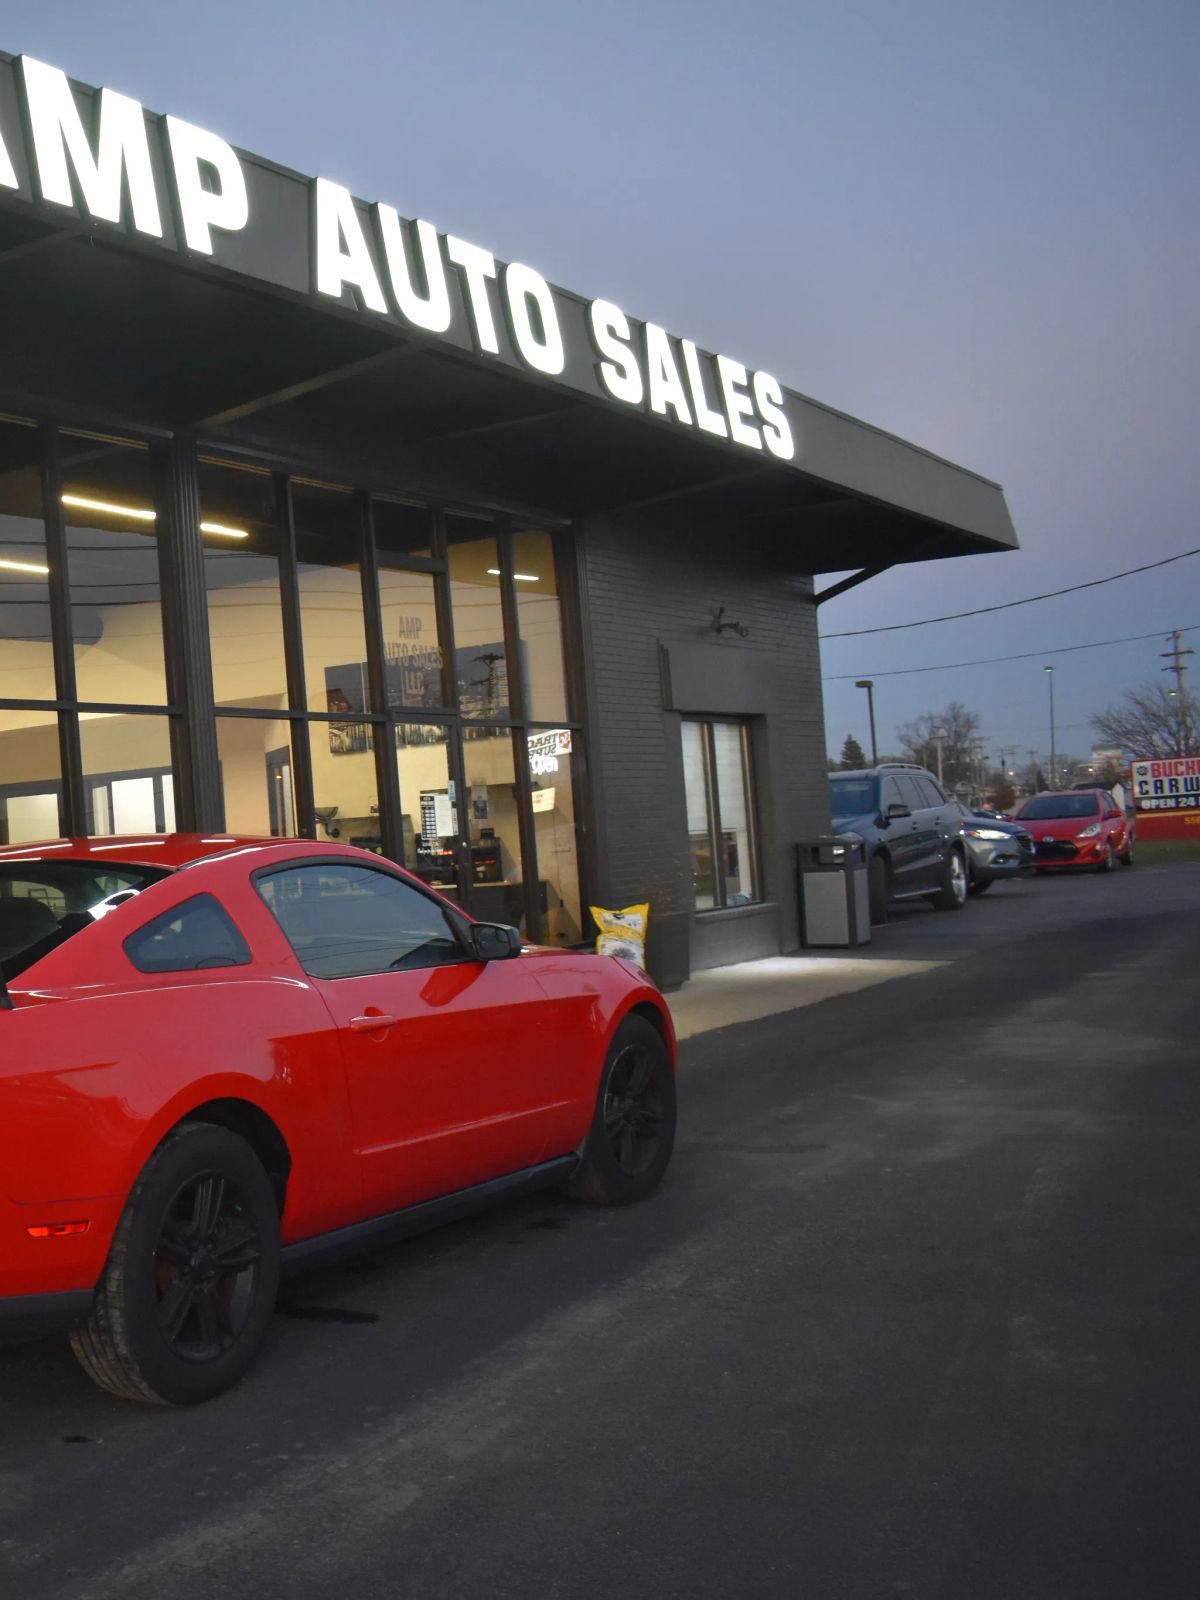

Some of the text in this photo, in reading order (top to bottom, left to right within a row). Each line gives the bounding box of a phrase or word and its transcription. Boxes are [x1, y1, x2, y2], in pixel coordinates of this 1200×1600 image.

[314, 176, 565, 376] AUTO
[590, 298, 795, 461] SALES
[399, 615, 422, 640] AMP
[383, 642, 443, 669] AUTO SALES
[1141, 798, 1176, 810] OPEN
[1178, 797, 1196, 807] 24
